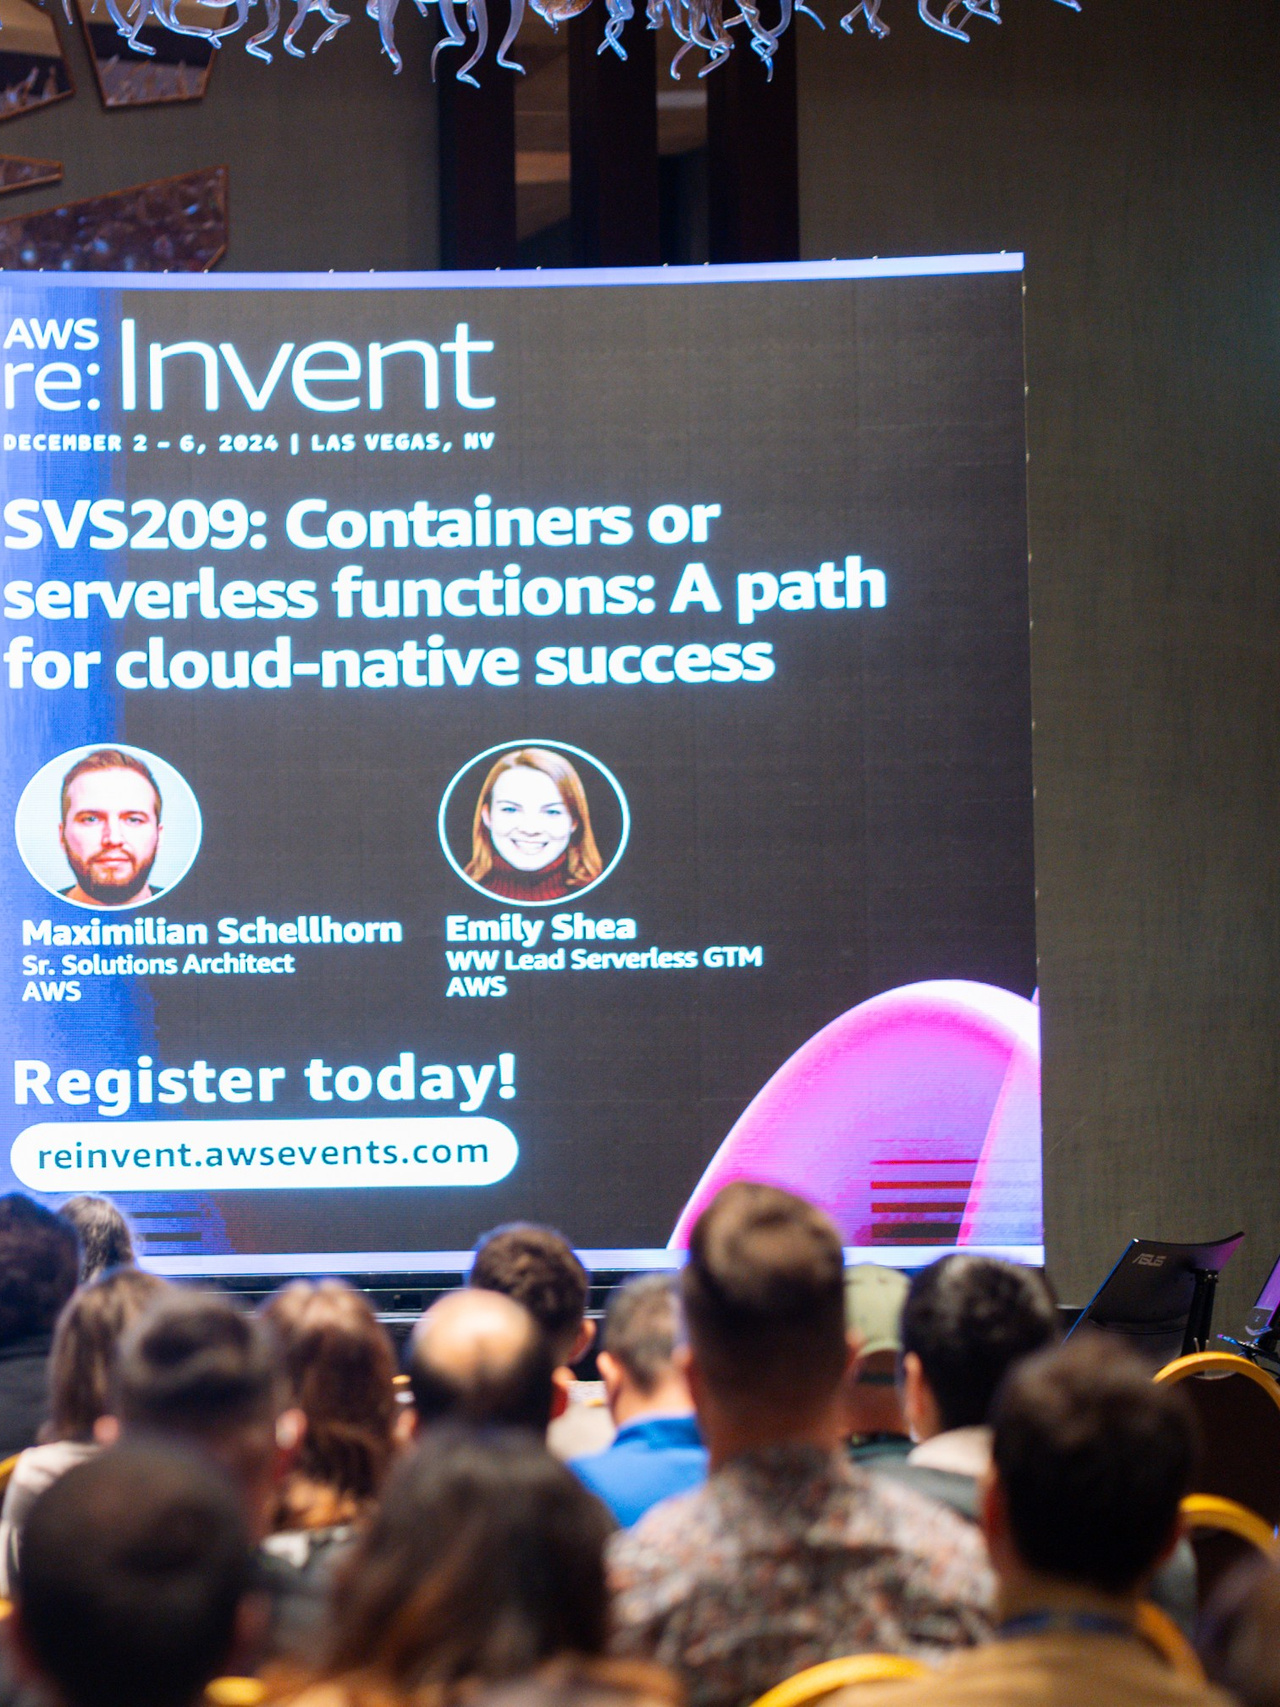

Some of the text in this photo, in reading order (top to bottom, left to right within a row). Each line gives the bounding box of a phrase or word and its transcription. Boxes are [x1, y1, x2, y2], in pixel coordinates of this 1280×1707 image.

[3, 318, 99, 350] AWS
[3, 433, 121, 451] DECEMBER
[134, 435, 146, 451] 2
[180, 435, 206, 454] 6,
[219, 434, 278, 451] 2024
[312, 434, 355, 451] LAS
[365, 433, 451, 452] VEGAS,
[465, 432, 494, 449] NV
[3, 494, 720, 550] SVS209: Containers or
[3, 556, 885, 624] serverless functions: A path
[3, 634, 774, 689] for cloud-native success
[22, 915, 401, 946] Maximilian Schellhorn
[447, 912, 635, 947] Emily Shea
[22, 952, 294, 976] Sr. Solutions Architect
[446, 946, 762, 971] WW Lead Serverless GTM
[22, 981, 81, 1002] AWS
[447, 976, 507, 997] AWS
[14, 1053, 515, 1116] Register today!
[38, 1140, 489, 1170] reinvent.awsevents.com
[1132, 1252, 1167, 1267] ASUS
